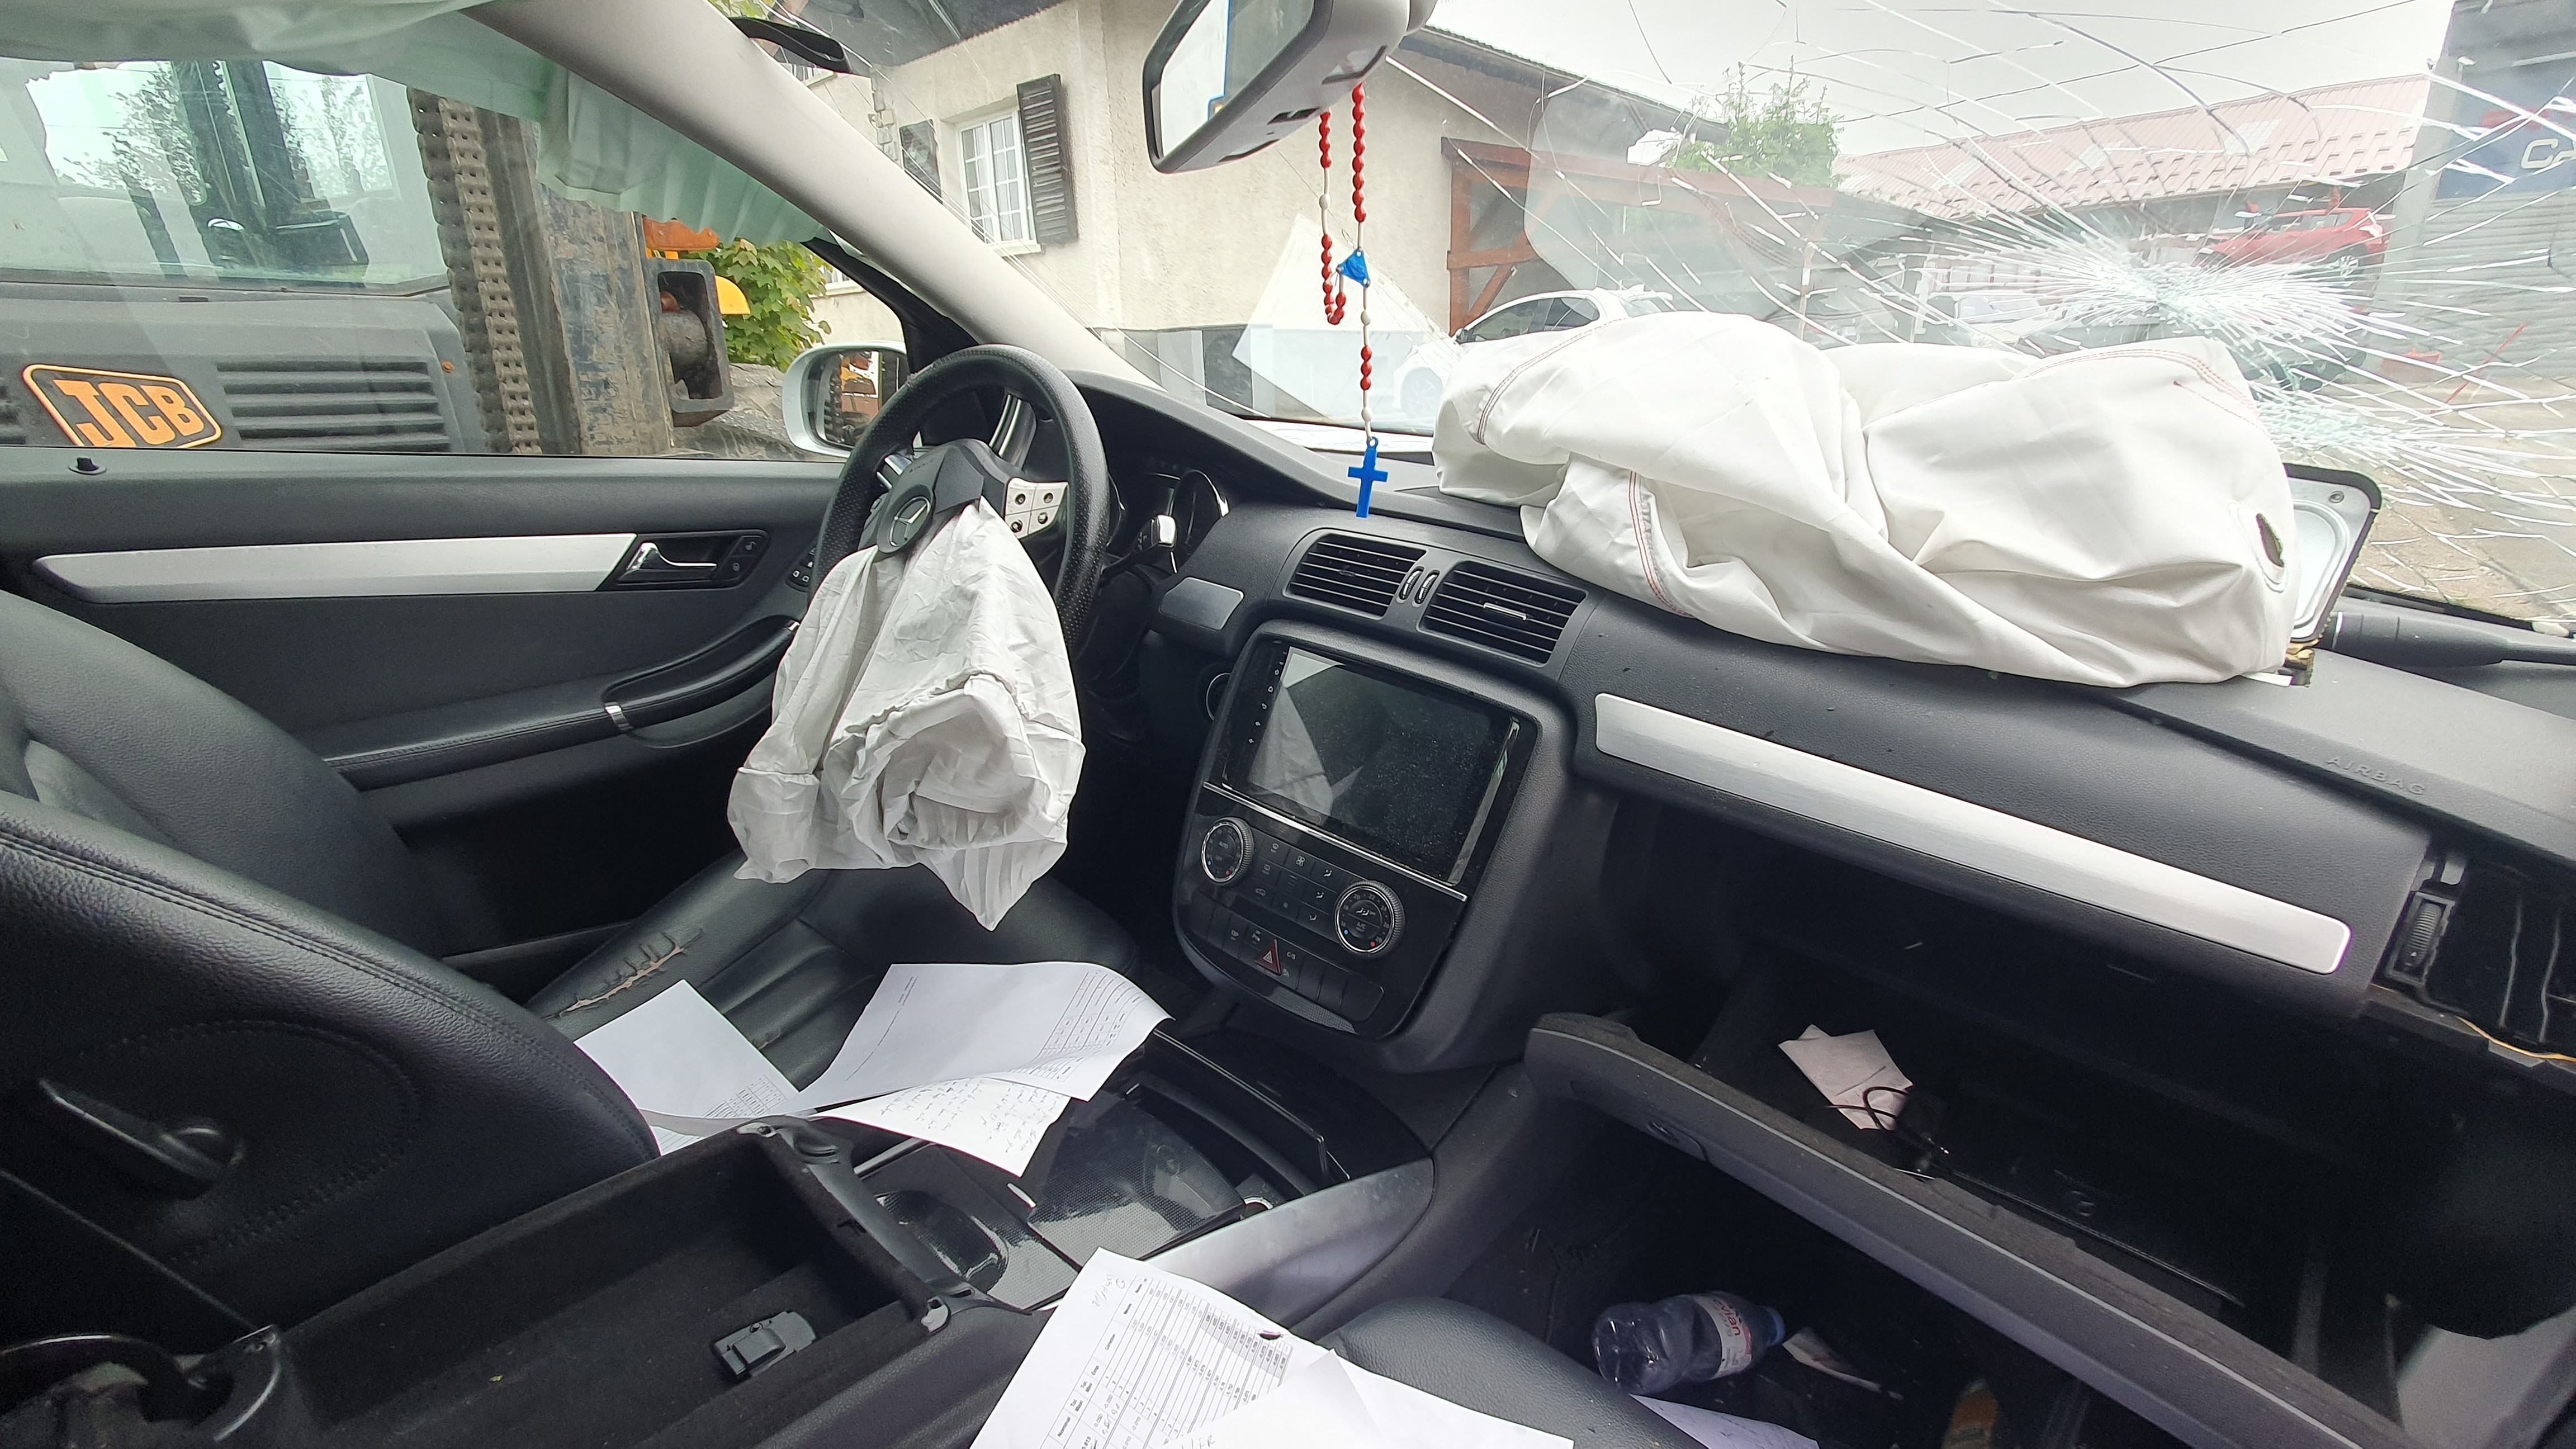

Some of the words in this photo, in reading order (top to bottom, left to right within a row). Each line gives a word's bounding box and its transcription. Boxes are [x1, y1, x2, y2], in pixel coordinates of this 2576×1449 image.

[54, 378, 205, 447] JCB
[2325, 756, 2426, 795] AIRBAG
[1712, 1299, 1741, 1336] evian
[1057, 1416, 1071, 1438] Nominal
